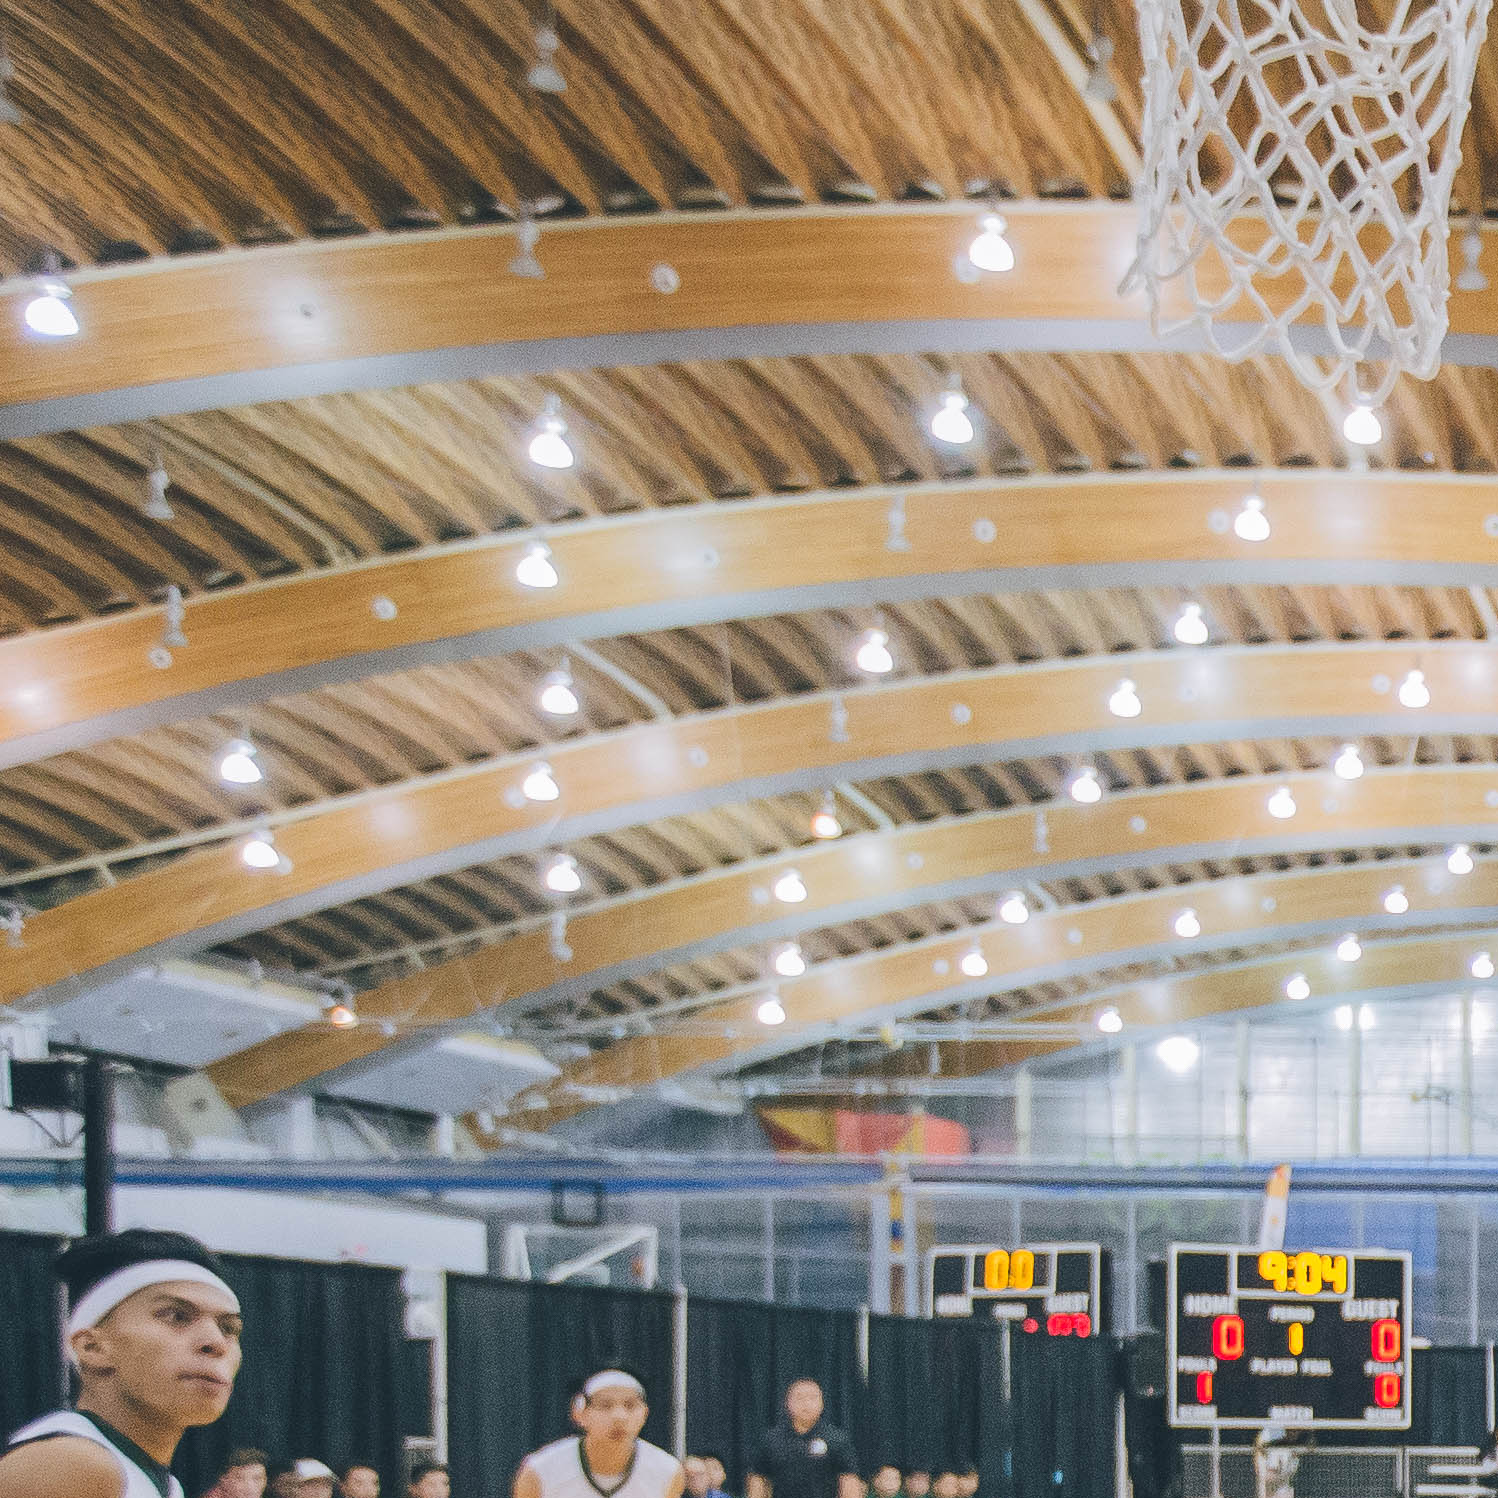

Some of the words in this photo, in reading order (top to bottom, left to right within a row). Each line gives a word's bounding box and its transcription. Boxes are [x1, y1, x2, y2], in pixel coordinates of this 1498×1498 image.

[1258, 1251, 1347, 1295] 9:04
[1212, 1314, 1244, 1361] 0
[1371, 1318, 1400, 1363] 0
[1374, 1372, 1400, 1409] 0
